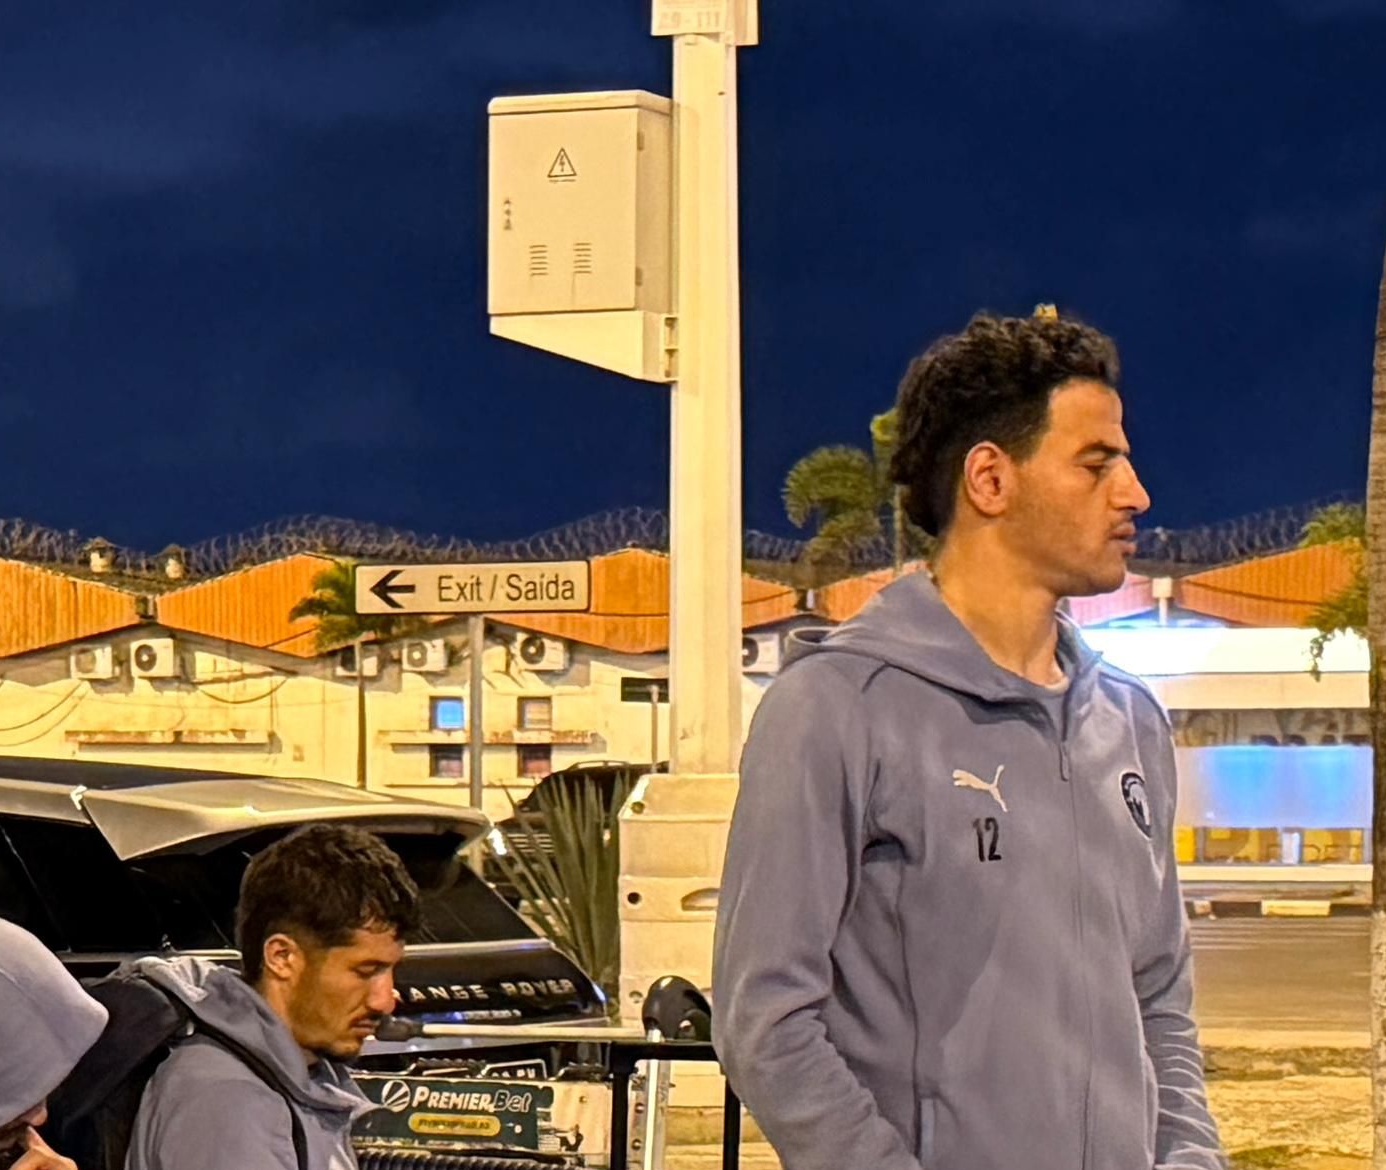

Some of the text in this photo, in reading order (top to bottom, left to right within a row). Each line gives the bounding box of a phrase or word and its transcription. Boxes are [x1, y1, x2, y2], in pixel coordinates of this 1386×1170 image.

[438, 574, 482, 602] Exit
[972, 817, 1002, 862] 12
[500, 978, 577, 998] ROVER
